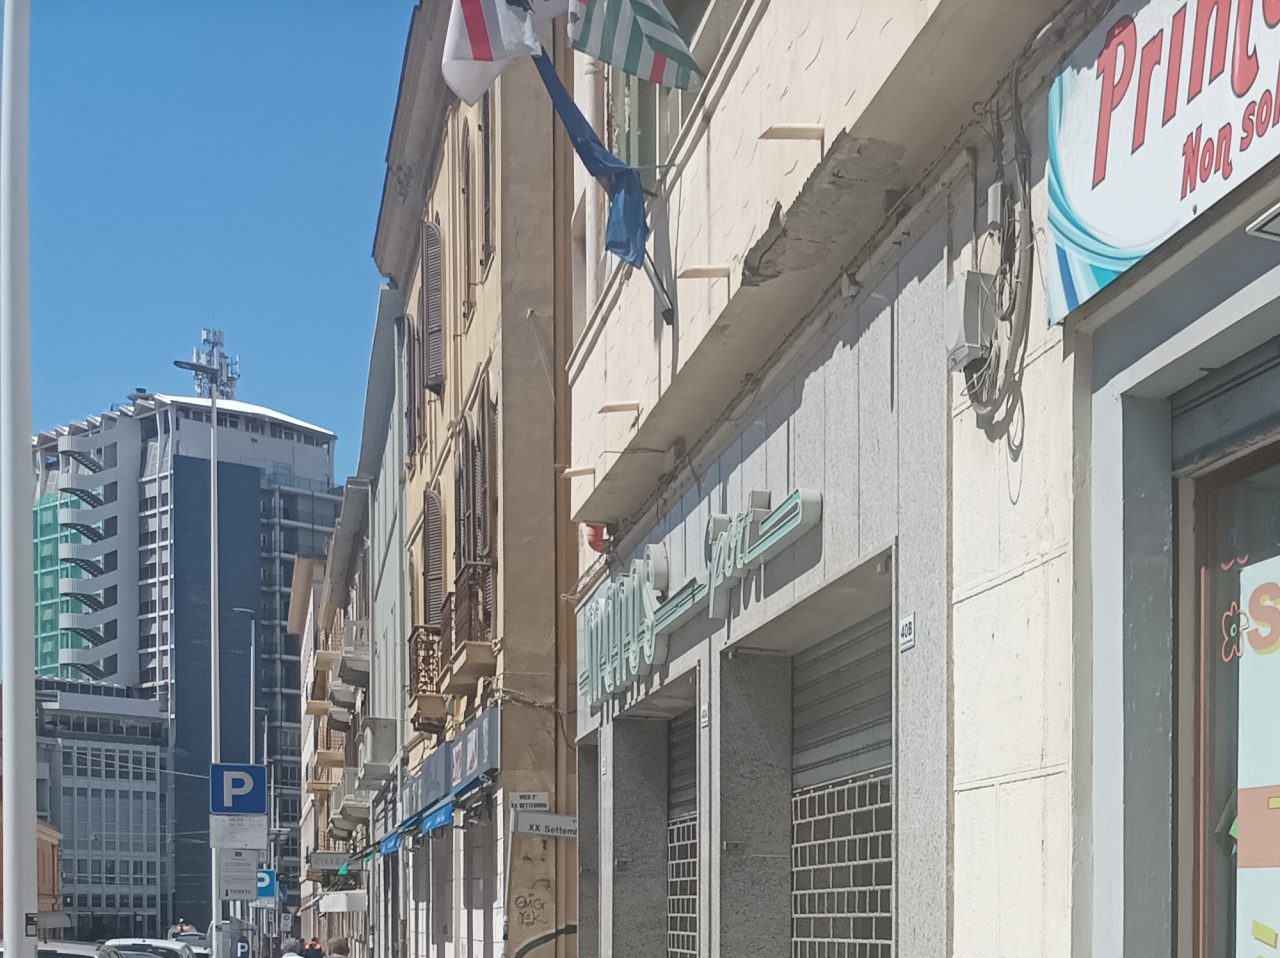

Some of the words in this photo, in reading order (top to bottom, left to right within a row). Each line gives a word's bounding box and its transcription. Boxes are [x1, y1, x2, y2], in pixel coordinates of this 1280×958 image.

[1181, 122, 1233, 200] Non
[223, 770, 254, 808] P
[528, 823, 541, 832] XX
[237, 942, 249, 957] P
